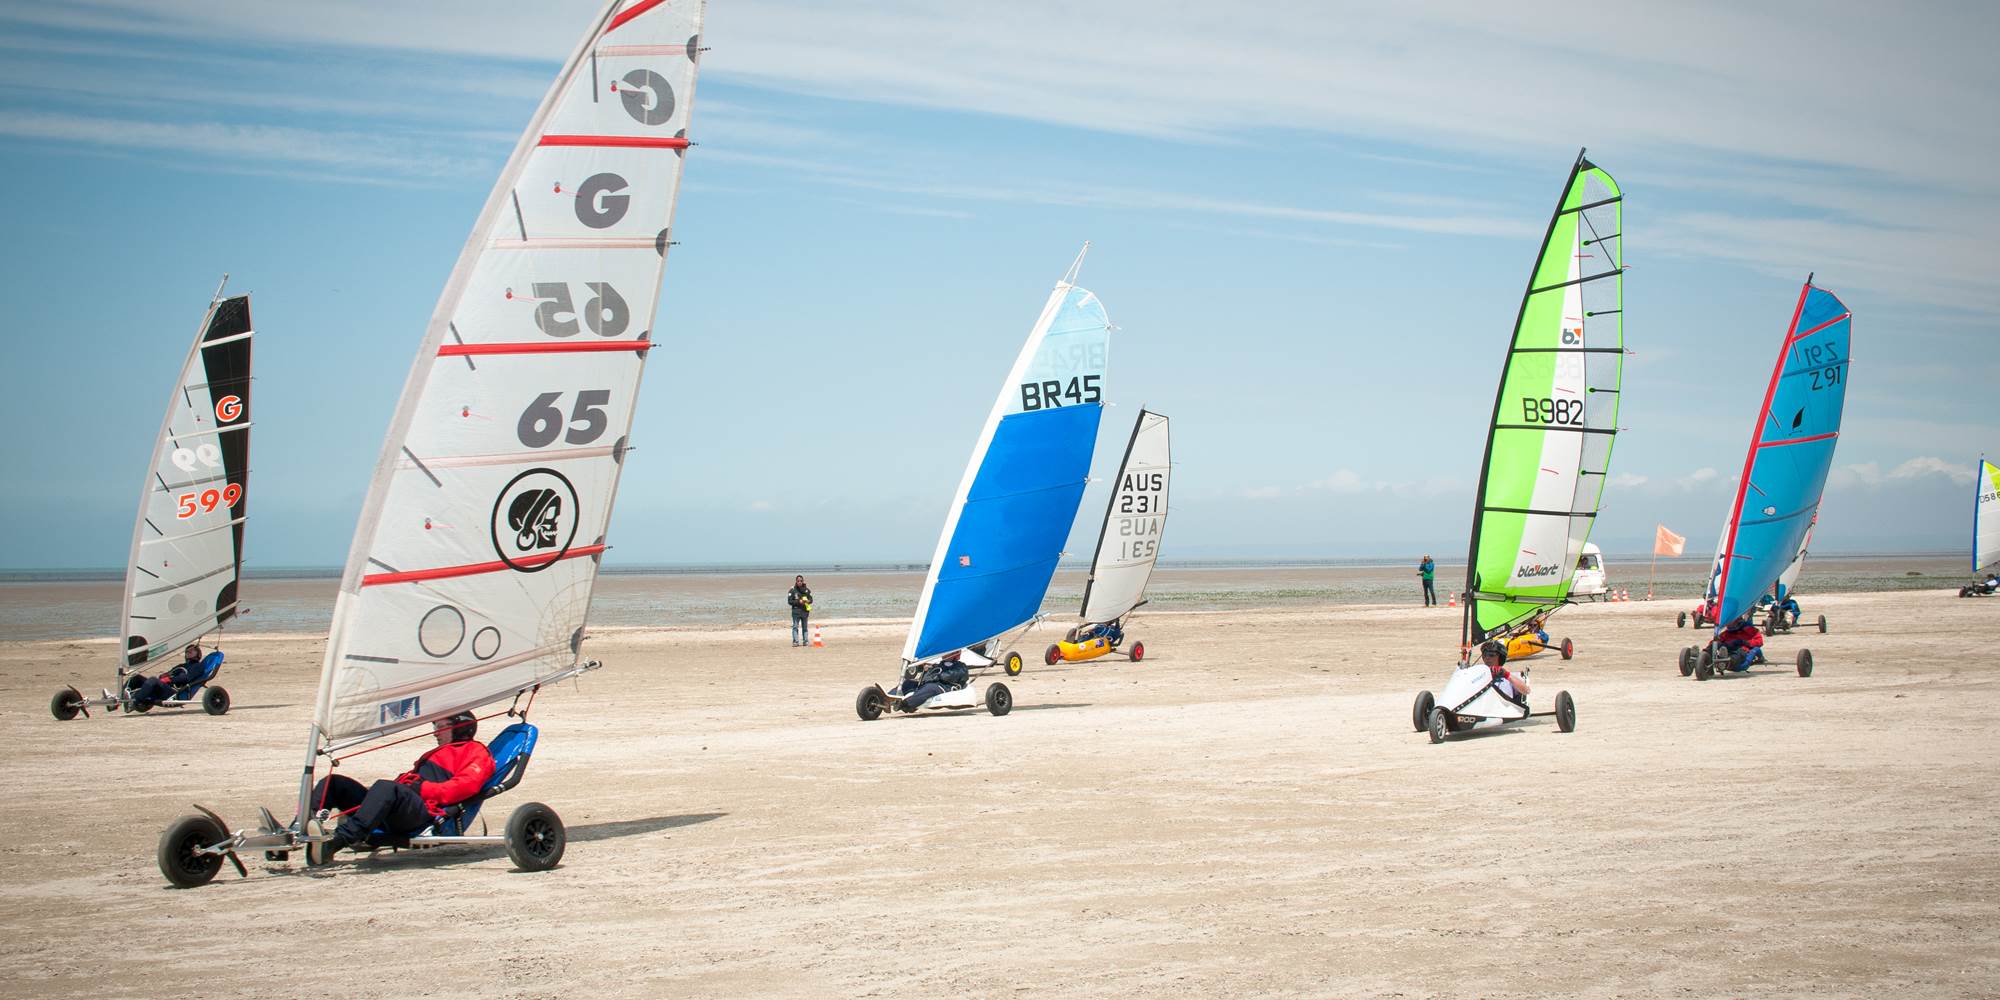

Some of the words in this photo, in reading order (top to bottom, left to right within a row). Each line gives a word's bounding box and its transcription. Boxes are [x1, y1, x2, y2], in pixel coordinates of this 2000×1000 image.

[574, 172, 631, 229] G
[1808, 371, 1823, 390] Z
[1824, 365, 1841, 387] 91
[1021, 374, 1101, 411] BR45
[215, 395, 243, 423] G
[517, 389, 611, 448] 65
[1522, 397, 1583, 426] B982
[1122, 473, 1163, 492] AUS
[176, 483, 242, 519] 599
[1120, 495, 1158, 513] 231
